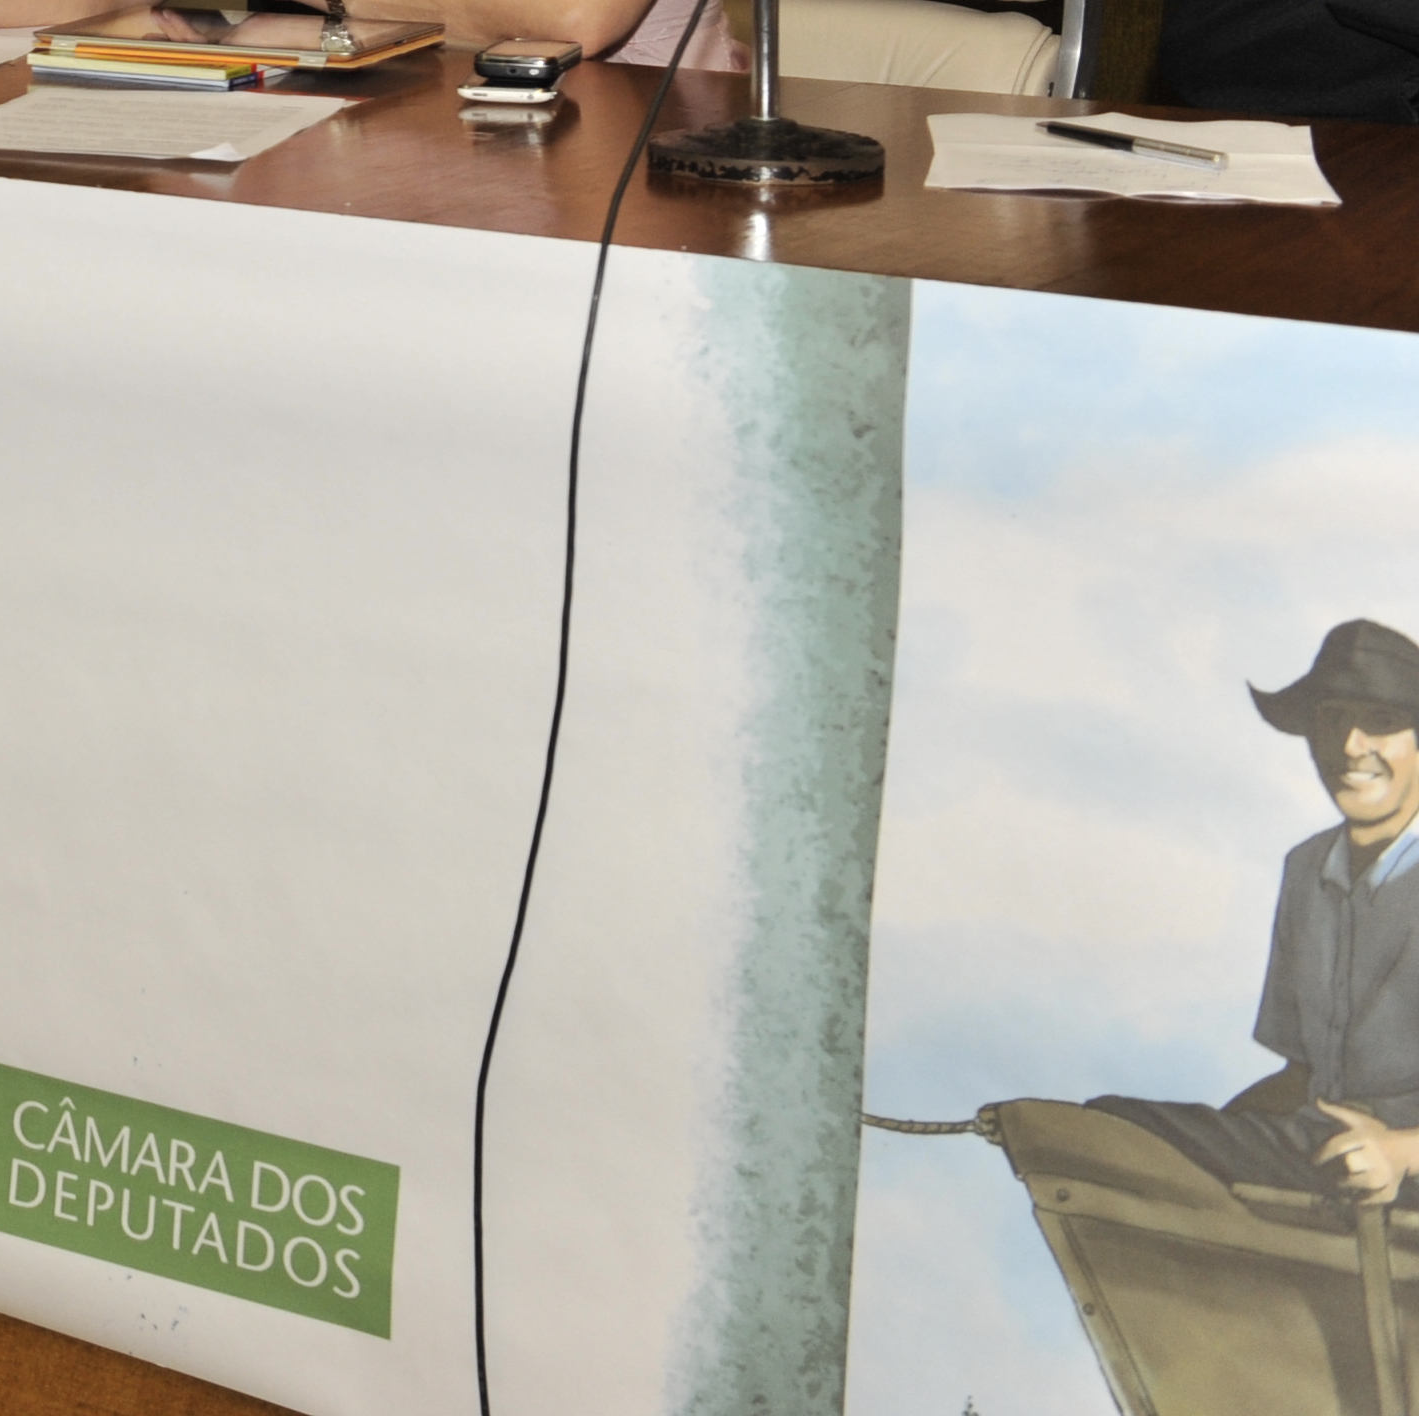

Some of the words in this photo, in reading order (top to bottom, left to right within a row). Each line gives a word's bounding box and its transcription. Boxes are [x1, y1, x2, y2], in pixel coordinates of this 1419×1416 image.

[7, 1157, 363, 1300] DEPUTADOS
[12, 1095, 235, 1204] CÂMARA
[249, 1159, 367, 1237] DOS
